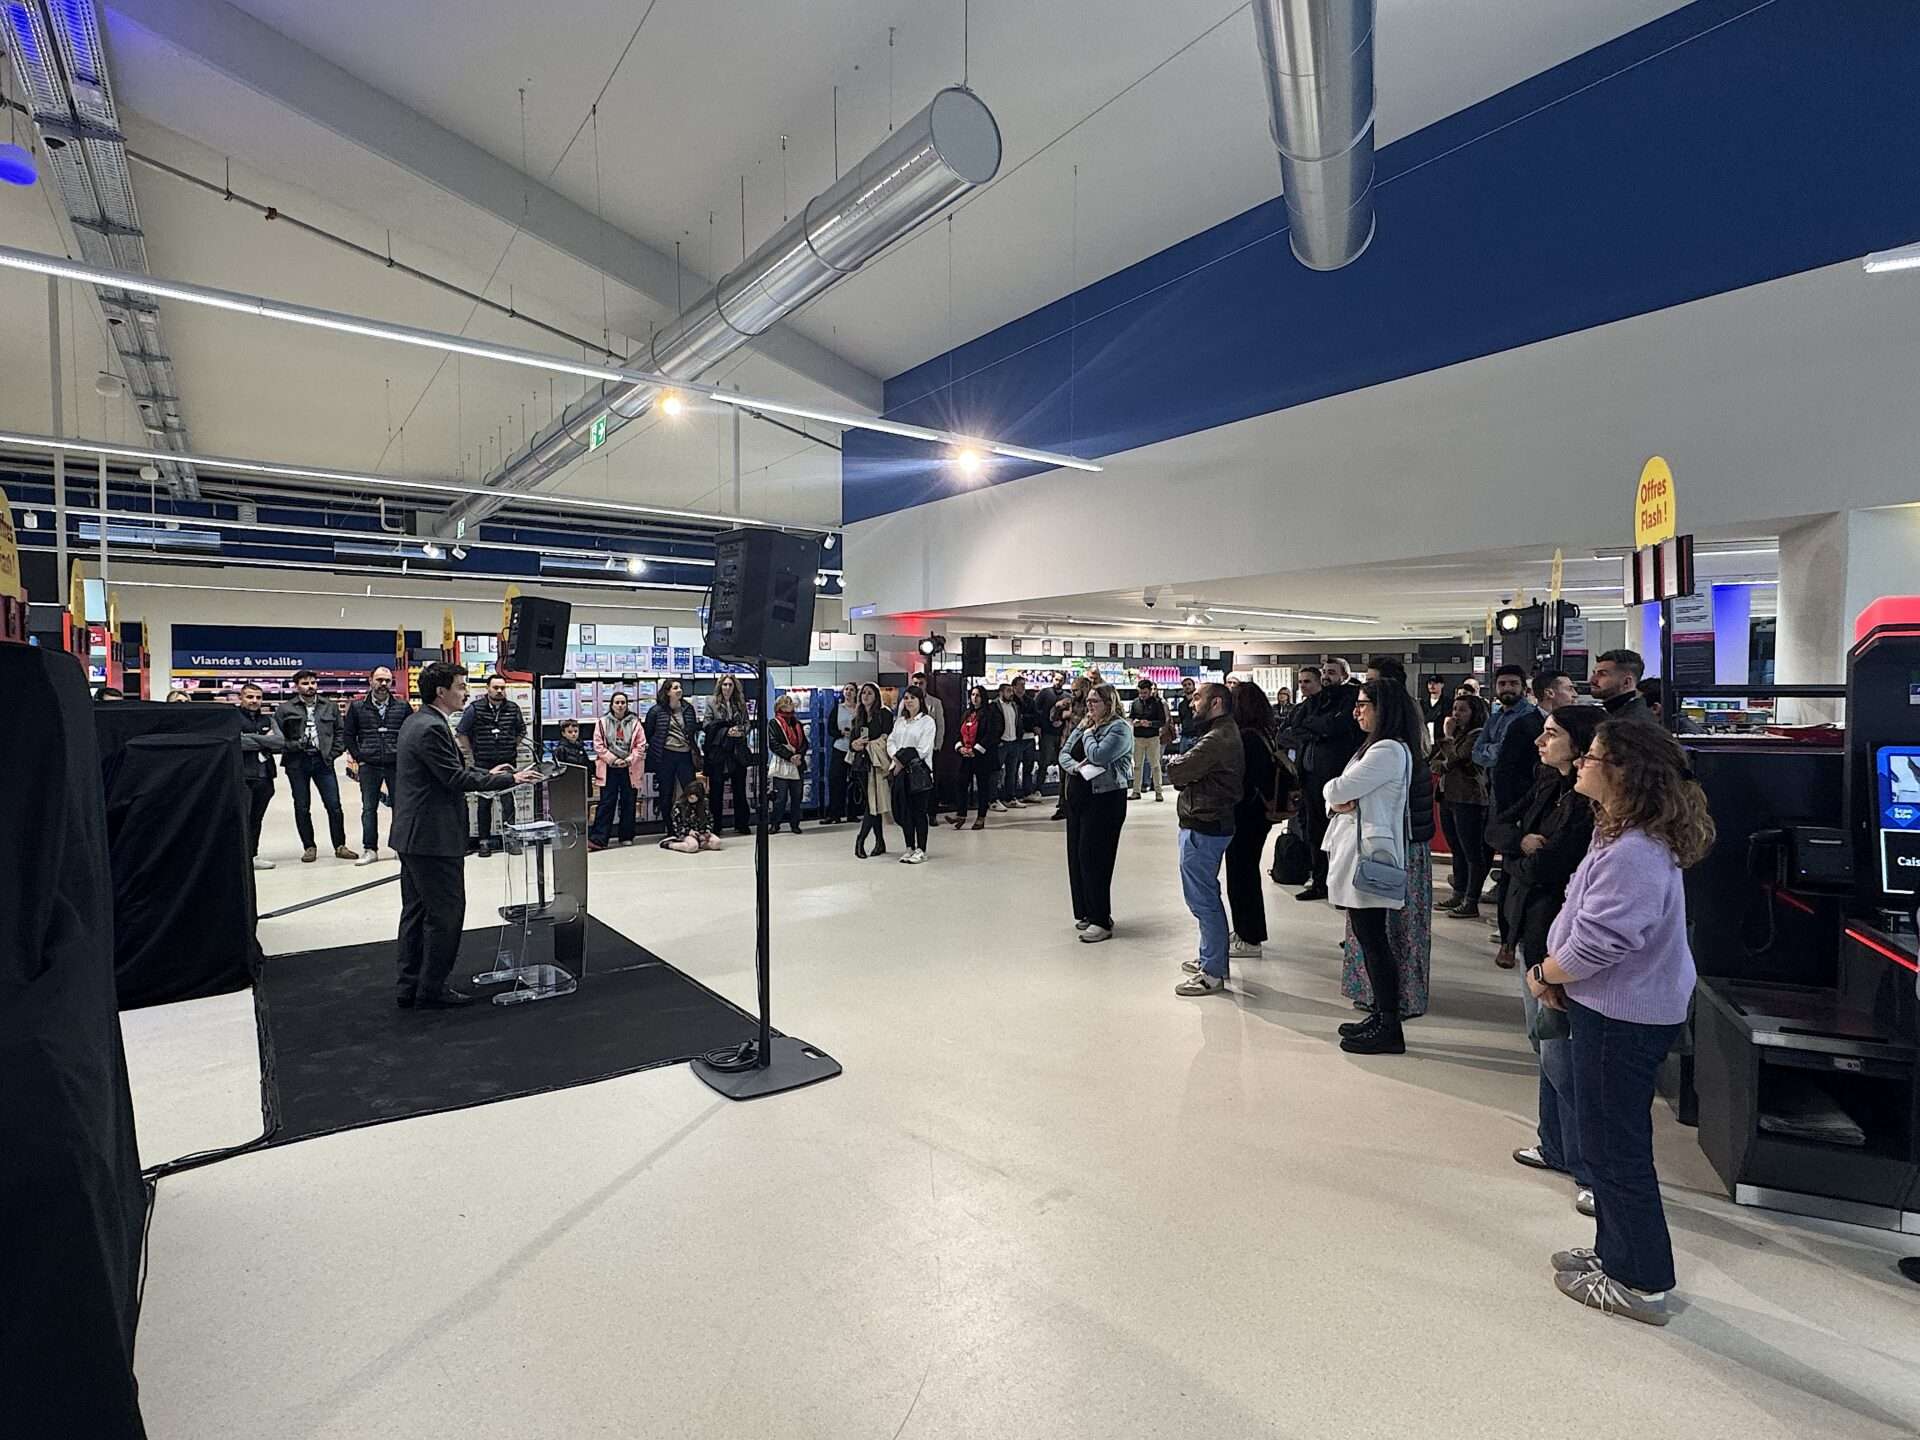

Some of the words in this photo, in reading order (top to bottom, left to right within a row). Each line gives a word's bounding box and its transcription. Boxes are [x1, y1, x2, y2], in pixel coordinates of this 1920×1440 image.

[1640, 478, 1667, 505] Offres
[1641, 503, 1663, 532] Flash
[191, 655, 241, 666] Viandes
[243, 656, 253, 667] &
[255, 657, 303, 667] volailles
